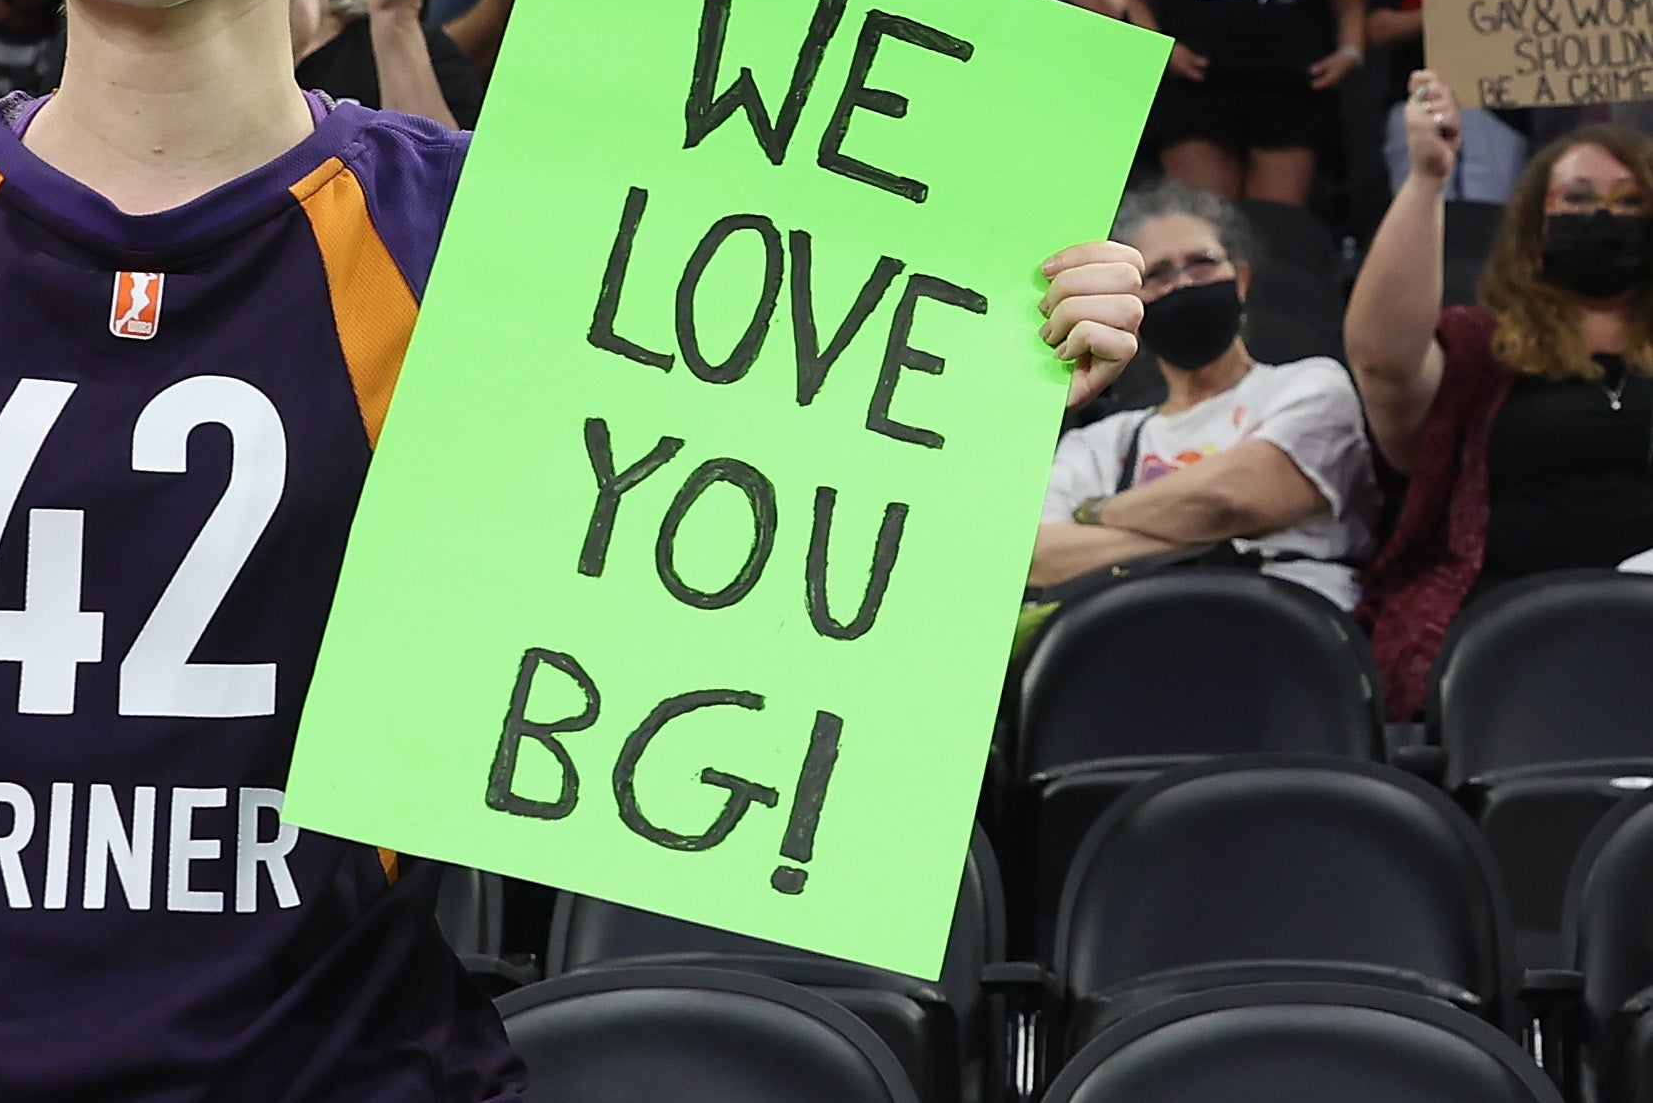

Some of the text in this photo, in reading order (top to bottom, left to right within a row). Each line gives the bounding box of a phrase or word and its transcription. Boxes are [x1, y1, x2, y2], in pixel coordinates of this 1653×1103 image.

[1478, 66, 1653, 107] BE A CRIME
[587, 186, 988, 449] LOVE
[577, 417, 910, 640] YOU
[485, 647, 844, 895] BG!
